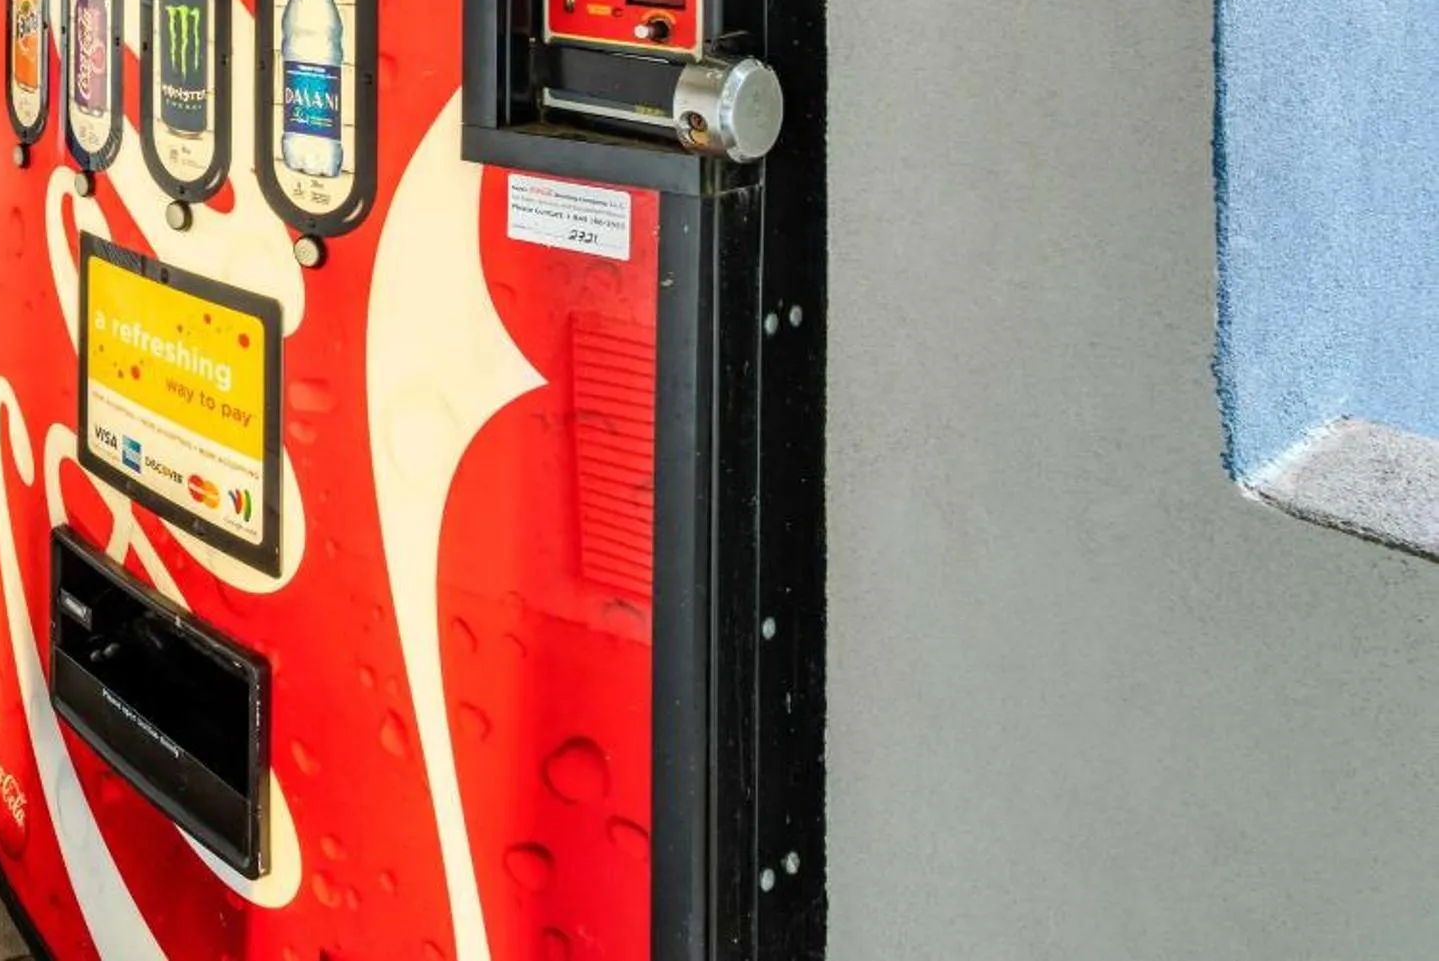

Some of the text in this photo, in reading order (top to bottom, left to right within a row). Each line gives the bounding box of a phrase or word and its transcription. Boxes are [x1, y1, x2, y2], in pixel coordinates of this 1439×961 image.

[285, 86, 339, 111] DASANI
[94, 308, 232, 390] a refreshing
[166, 376, 253, 428] way to pay
[94, 424, 118, 451] VISA
